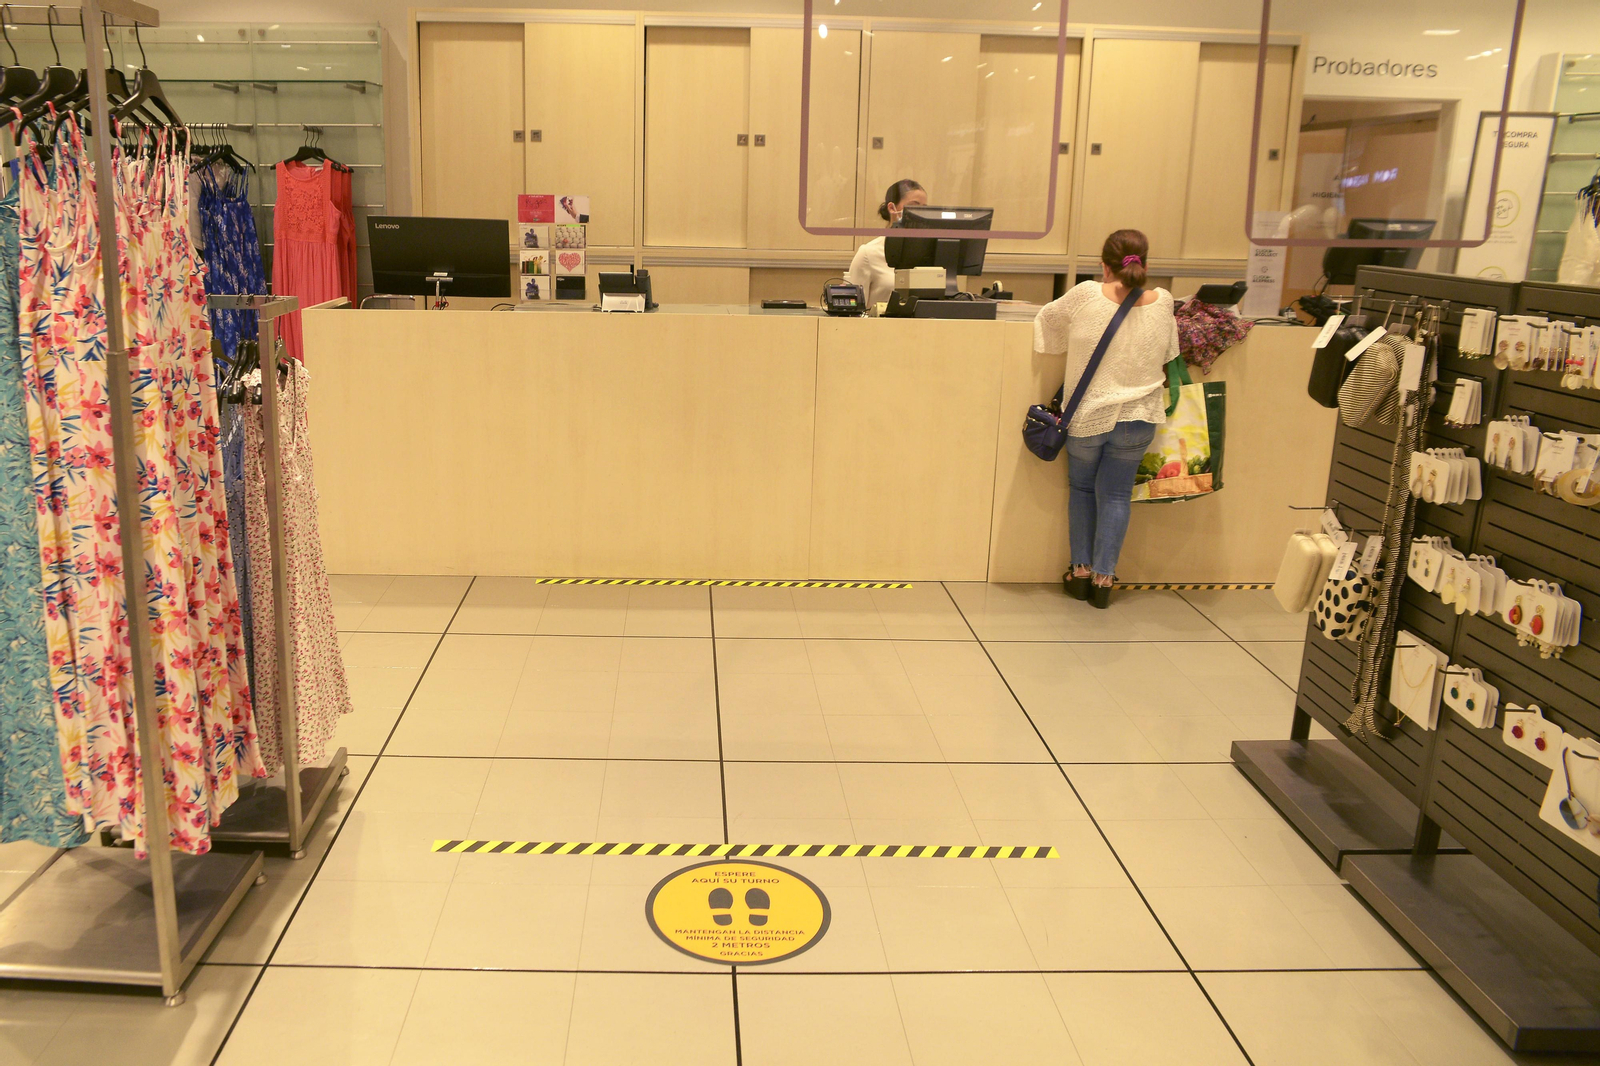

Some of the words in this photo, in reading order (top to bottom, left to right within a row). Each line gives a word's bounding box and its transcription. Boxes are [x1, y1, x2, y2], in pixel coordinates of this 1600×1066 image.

[1312, 56, 1438, 78] Probadores
[1506, 131, 1538, 139] COMPRA
[374, 222, 400, 230] Lenovo
